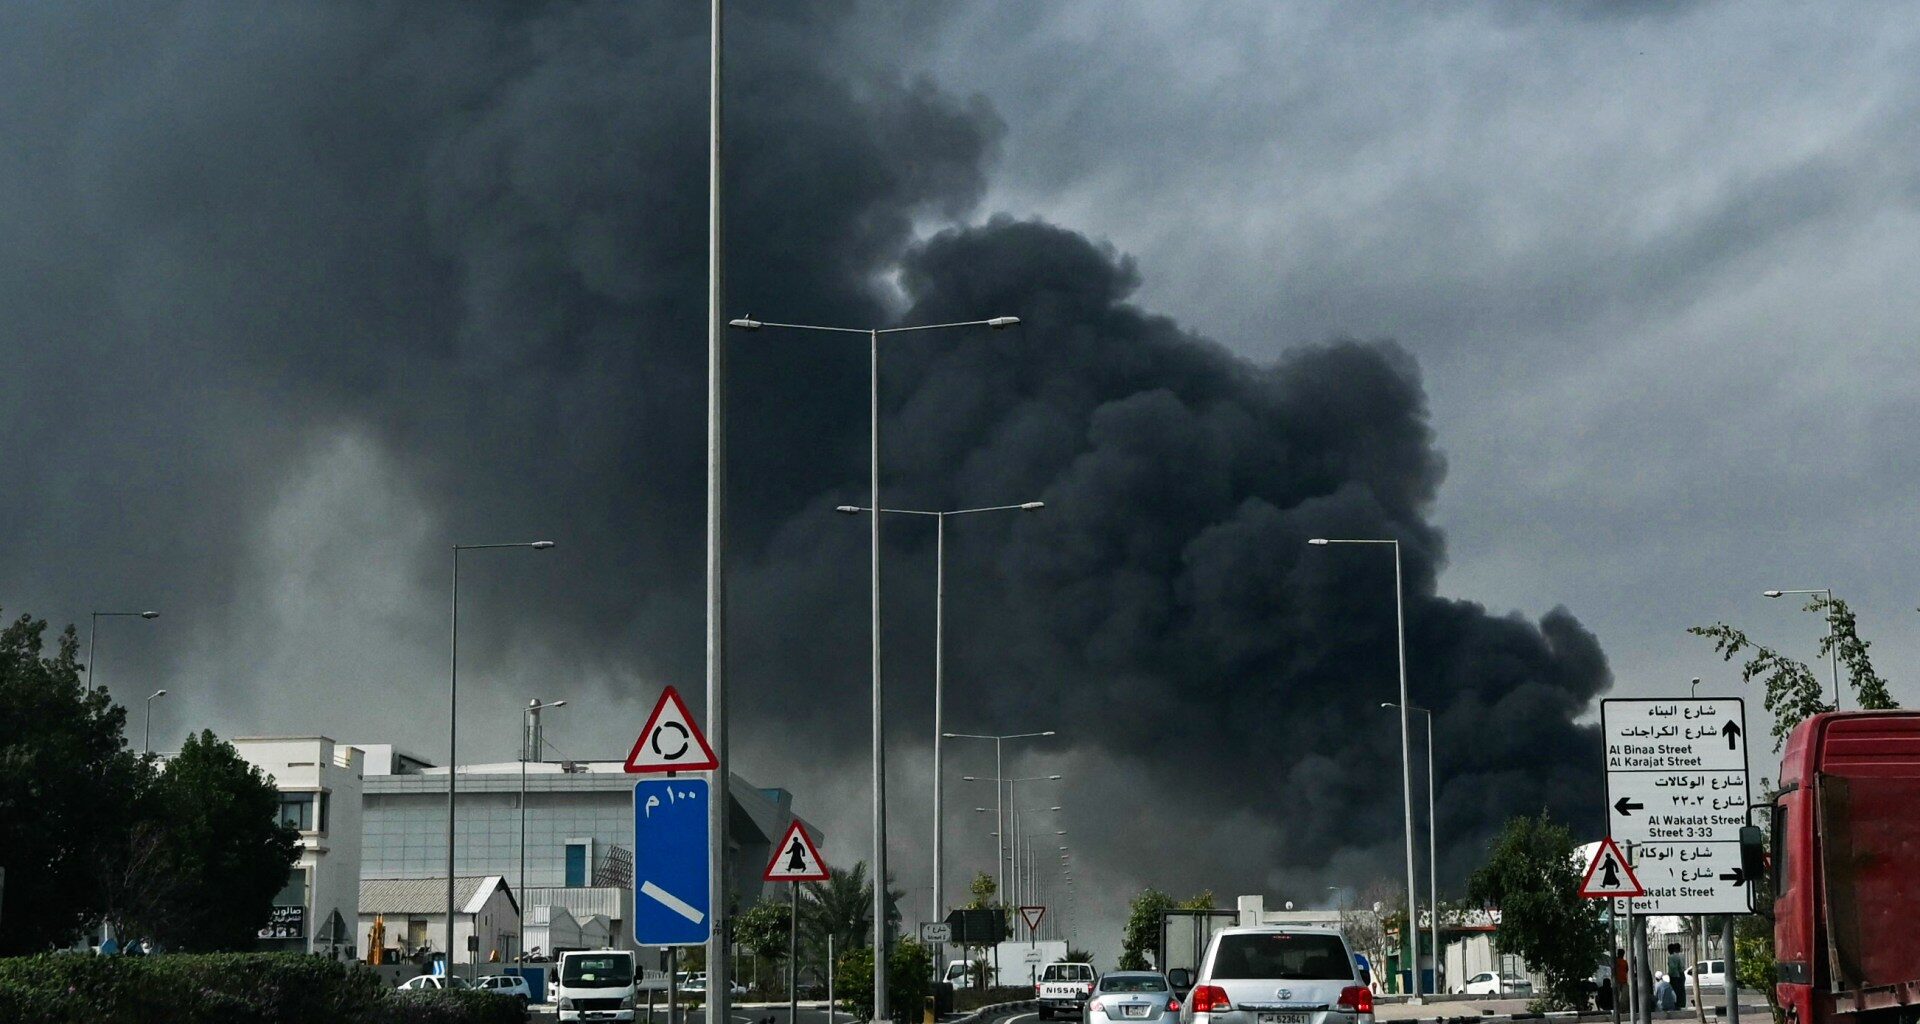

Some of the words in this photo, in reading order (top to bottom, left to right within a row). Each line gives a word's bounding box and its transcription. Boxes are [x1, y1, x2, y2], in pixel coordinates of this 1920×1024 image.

[1649, 706, 1676, 718] البناء
[1685, 706, 1715, 719] شارع
[1621, 726, 1678, 738] الكراجات
[1686, 726, 1717, 739] شارع
[1610, 745, 1620, 754] Al
[1624, 745, 1654, 754] Binaa
[1658, 745, 1692, 754] Street
[1610, 757, 1621, 766] Al
[1625, 757, 1663, 768] Karajat
[1668, 757, 1701, 765] Street
[1655, 776, 1704, 789] الوكالات
[1712, 776, 1743, 790] شارع
[1713, 796, 1744, 810] شارع
[1649, 816, 1659, 825] Al
[1663, 816, 1707, 825] Wakalat
[1711, 815, 1744, 824] Street
[1650, 828, 1683, 837] Street
[1687, 827, 1712, 837] 3-33
[1680, 847, 1712, 861] شارع
[1682, 868, 1713, 882] شارع
[1643, 887, 1676, 897] akalat
[1680, 887, 1714, 896] Street
[1617, 900, 1651, 910] Seet
[1655, 900, 1658, 909] 1
